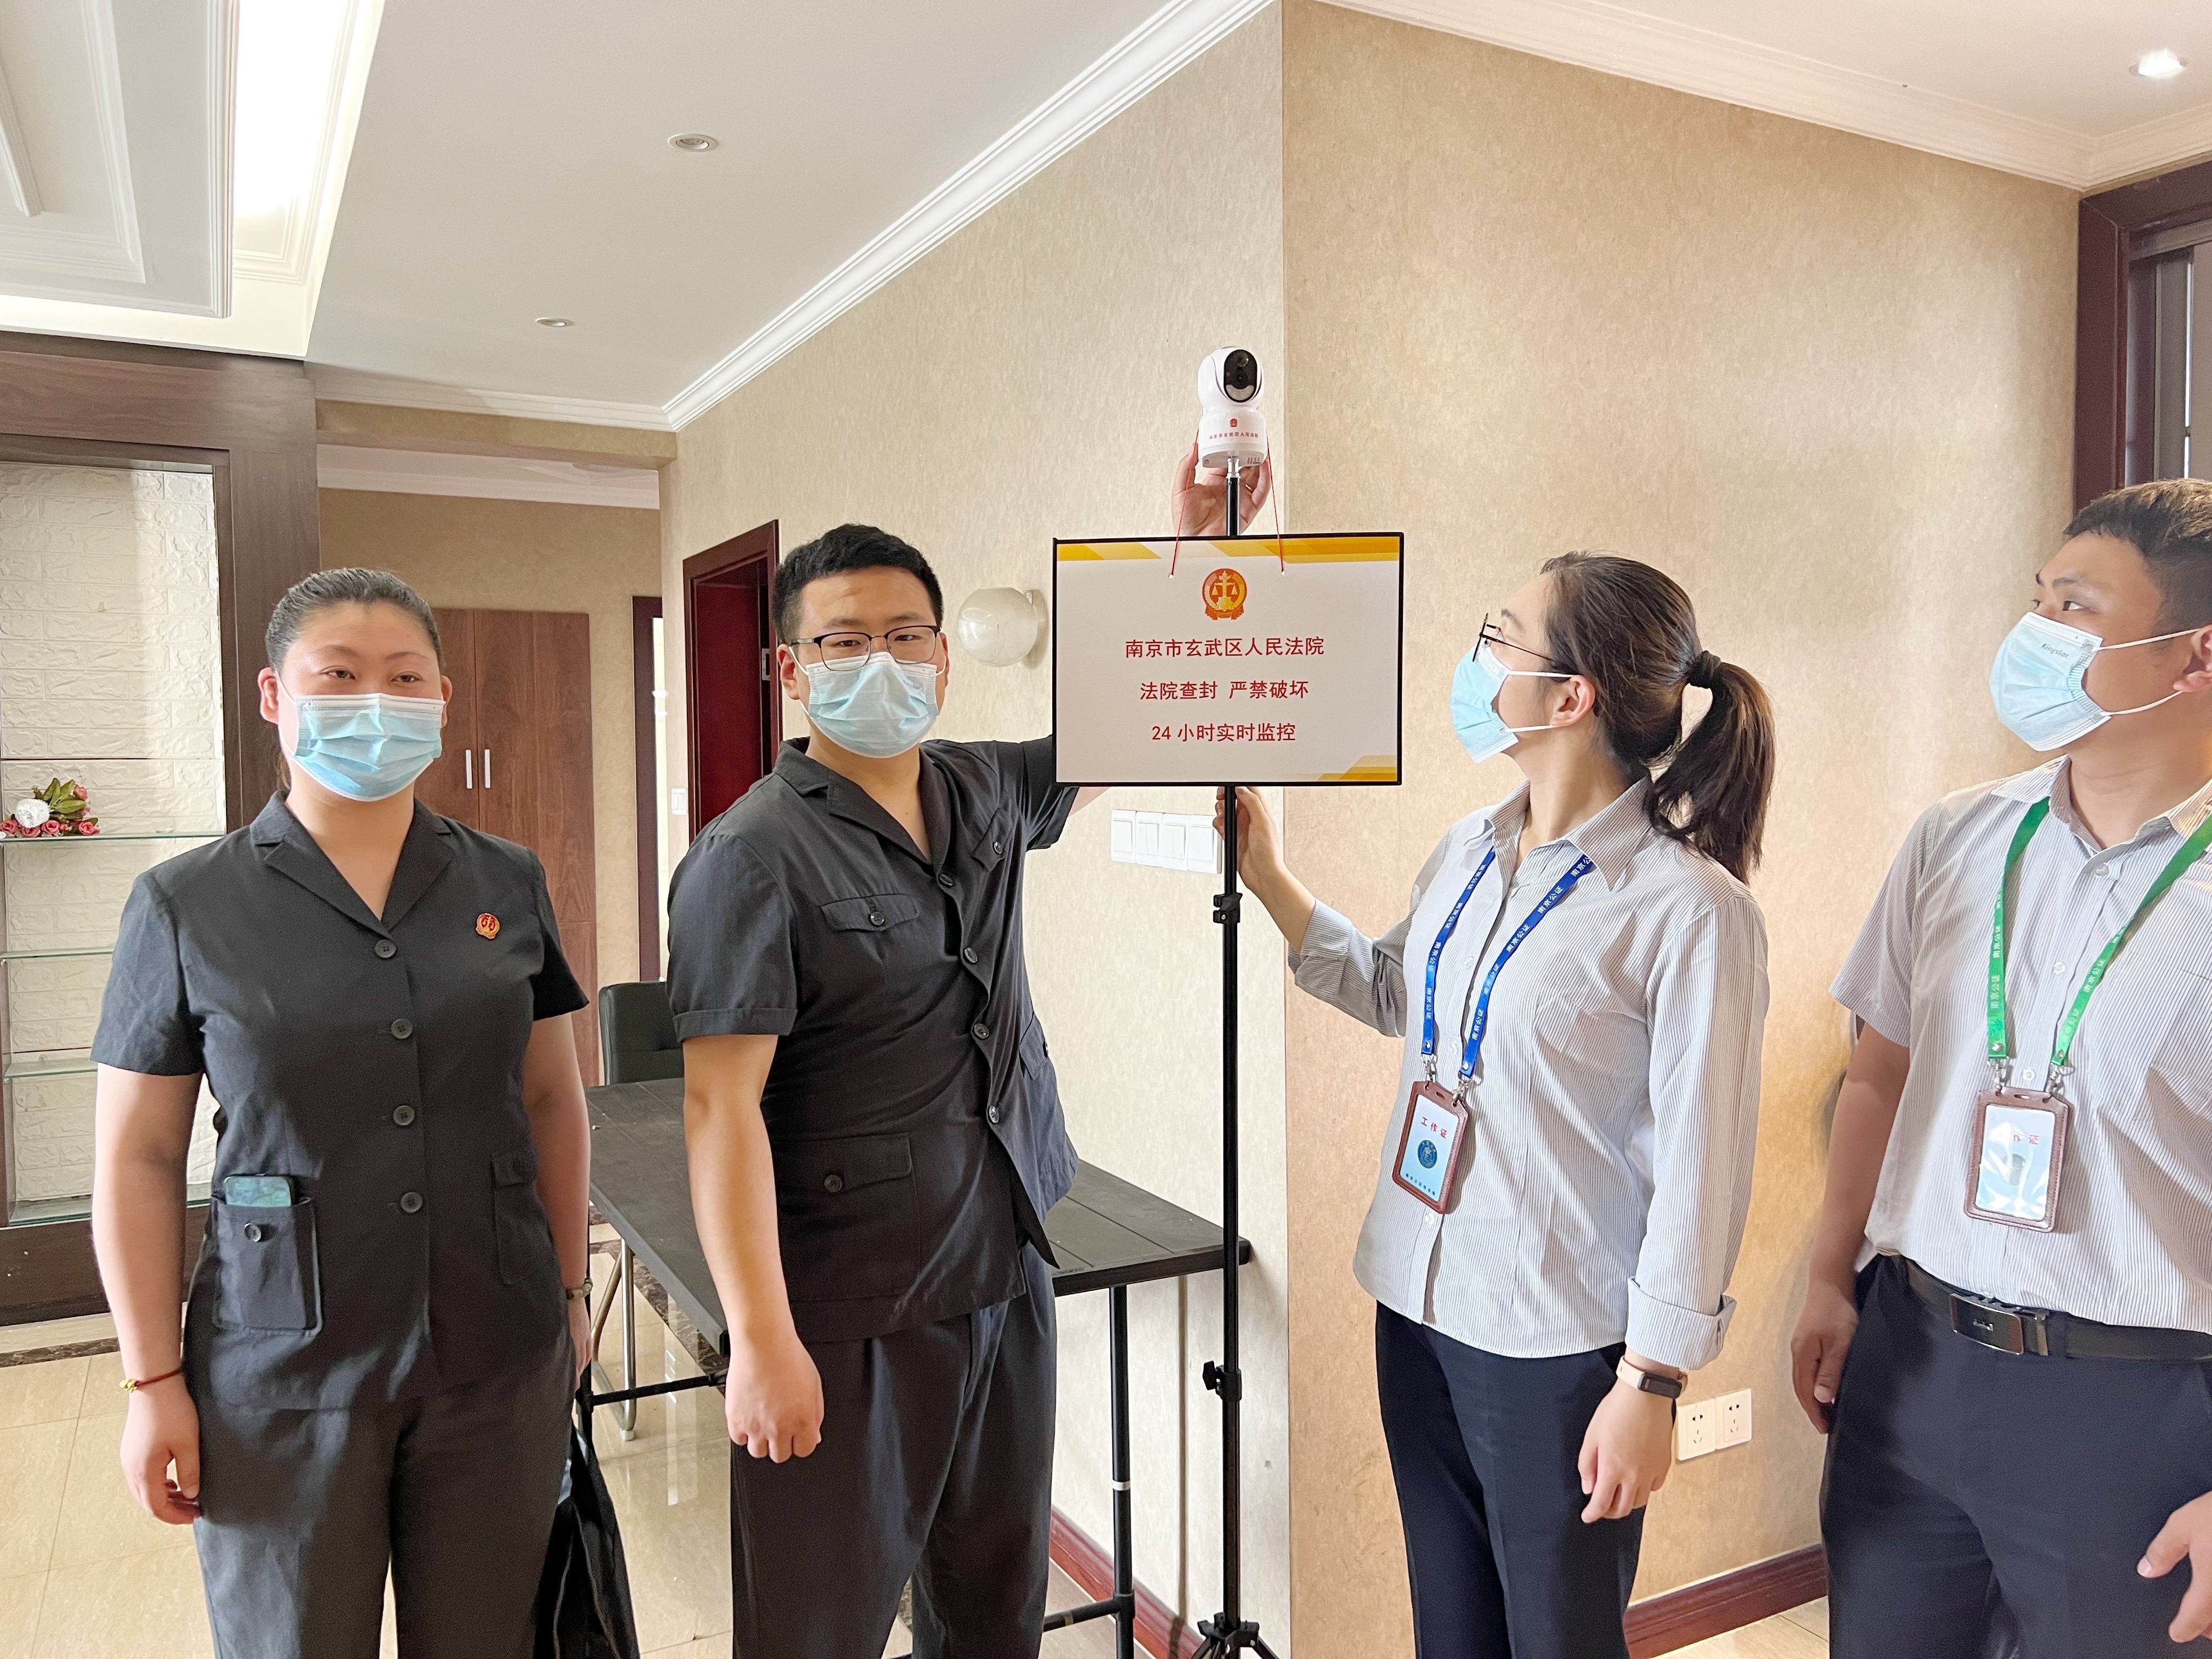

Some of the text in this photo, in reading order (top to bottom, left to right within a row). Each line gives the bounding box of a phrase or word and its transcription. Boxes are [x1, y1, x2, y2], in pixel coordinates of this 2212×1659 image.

[1125, 636, 1324, 658] 南京市玄武区人民法院
[1140, 680, 1309, 700] 法院查封 严禁破坏
[1152, 723, 1296, 742] 24 小时实时监控
[1537, 885, 1564, 914] 南京公证
[1505, 923, 1531, 952] 南京公证
[1471, 1008, 1484, 1041] 南京公证
[1420, 1116, 1447, 1139] 工作证
